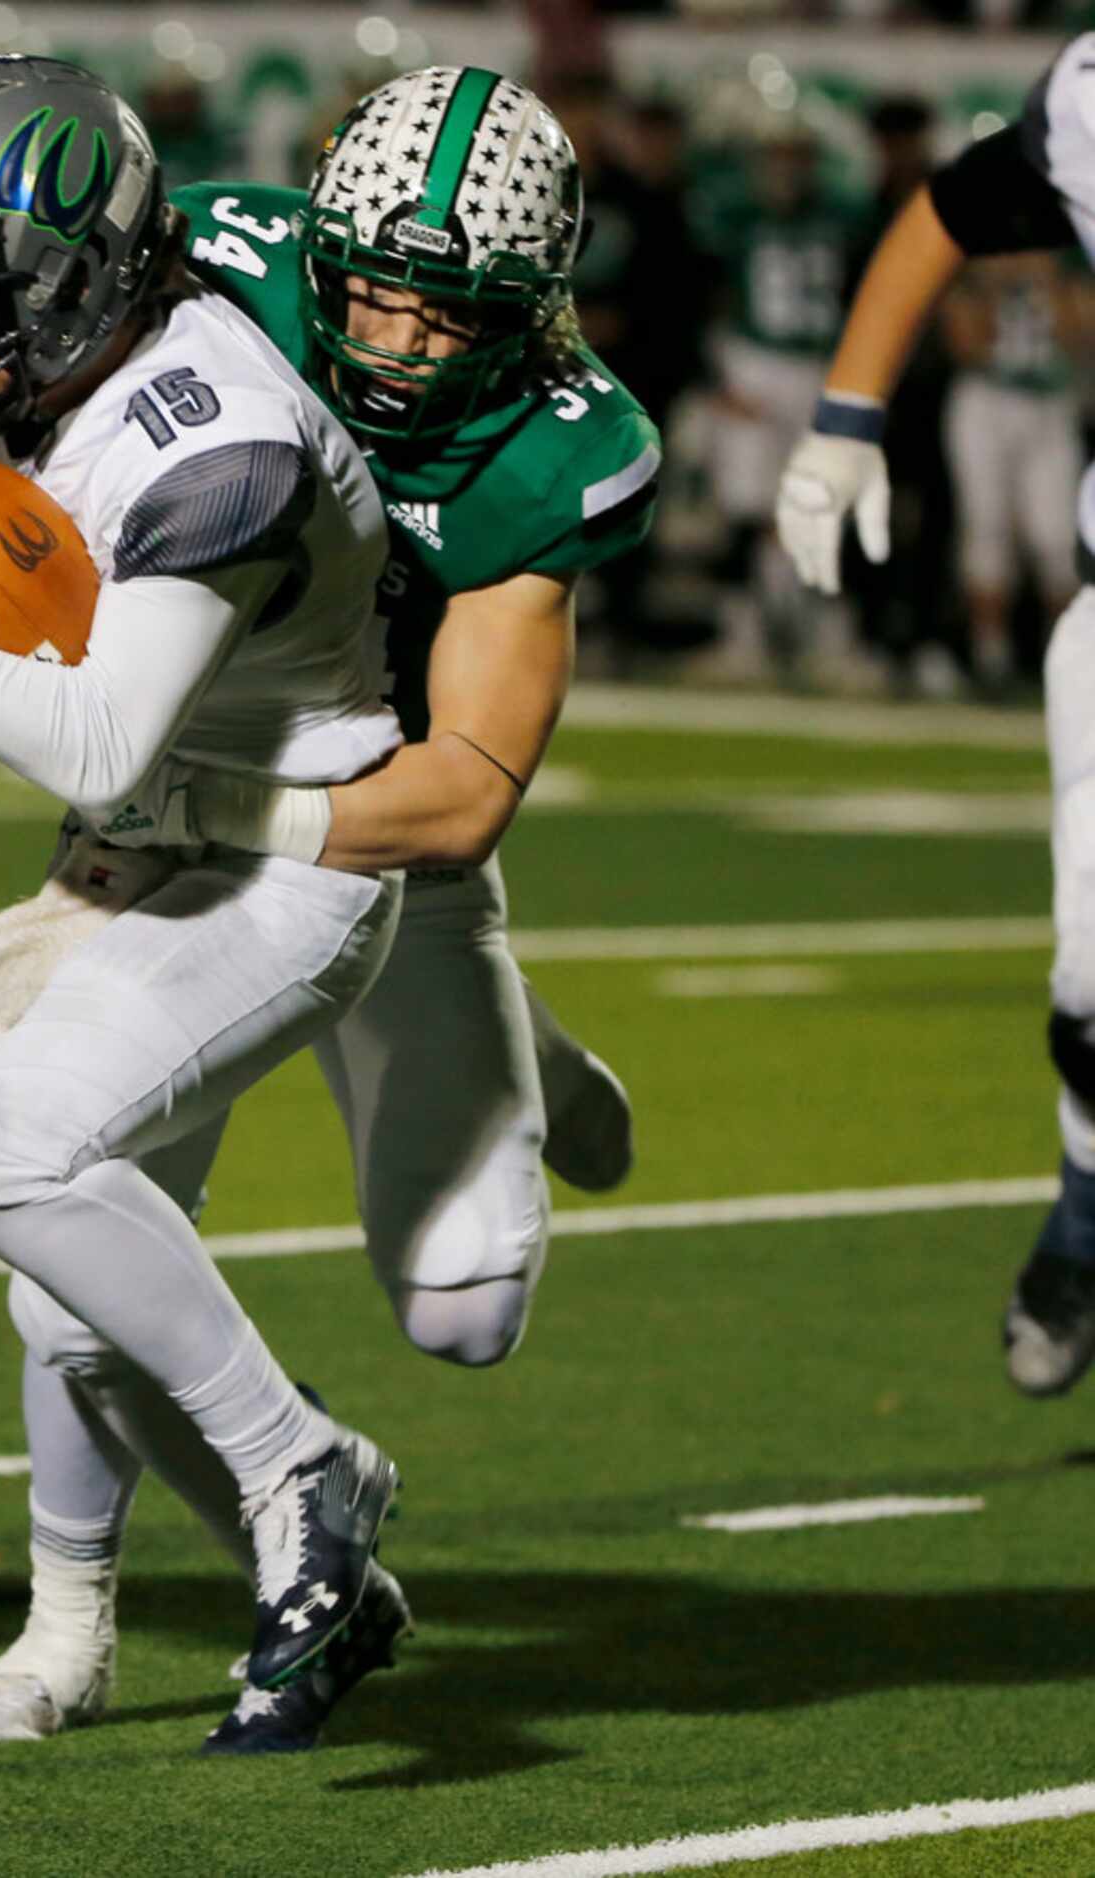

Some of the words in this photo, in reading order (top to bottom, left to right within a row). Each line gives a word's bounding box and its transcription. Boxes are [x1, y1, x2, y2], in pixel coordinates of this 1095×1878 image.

[191, 196, 290, 280] 34
[398, 222, 448, 249] DRAGONS
[123, 366, 222, 451] 15
[386, 504, 445, 551] adidas
